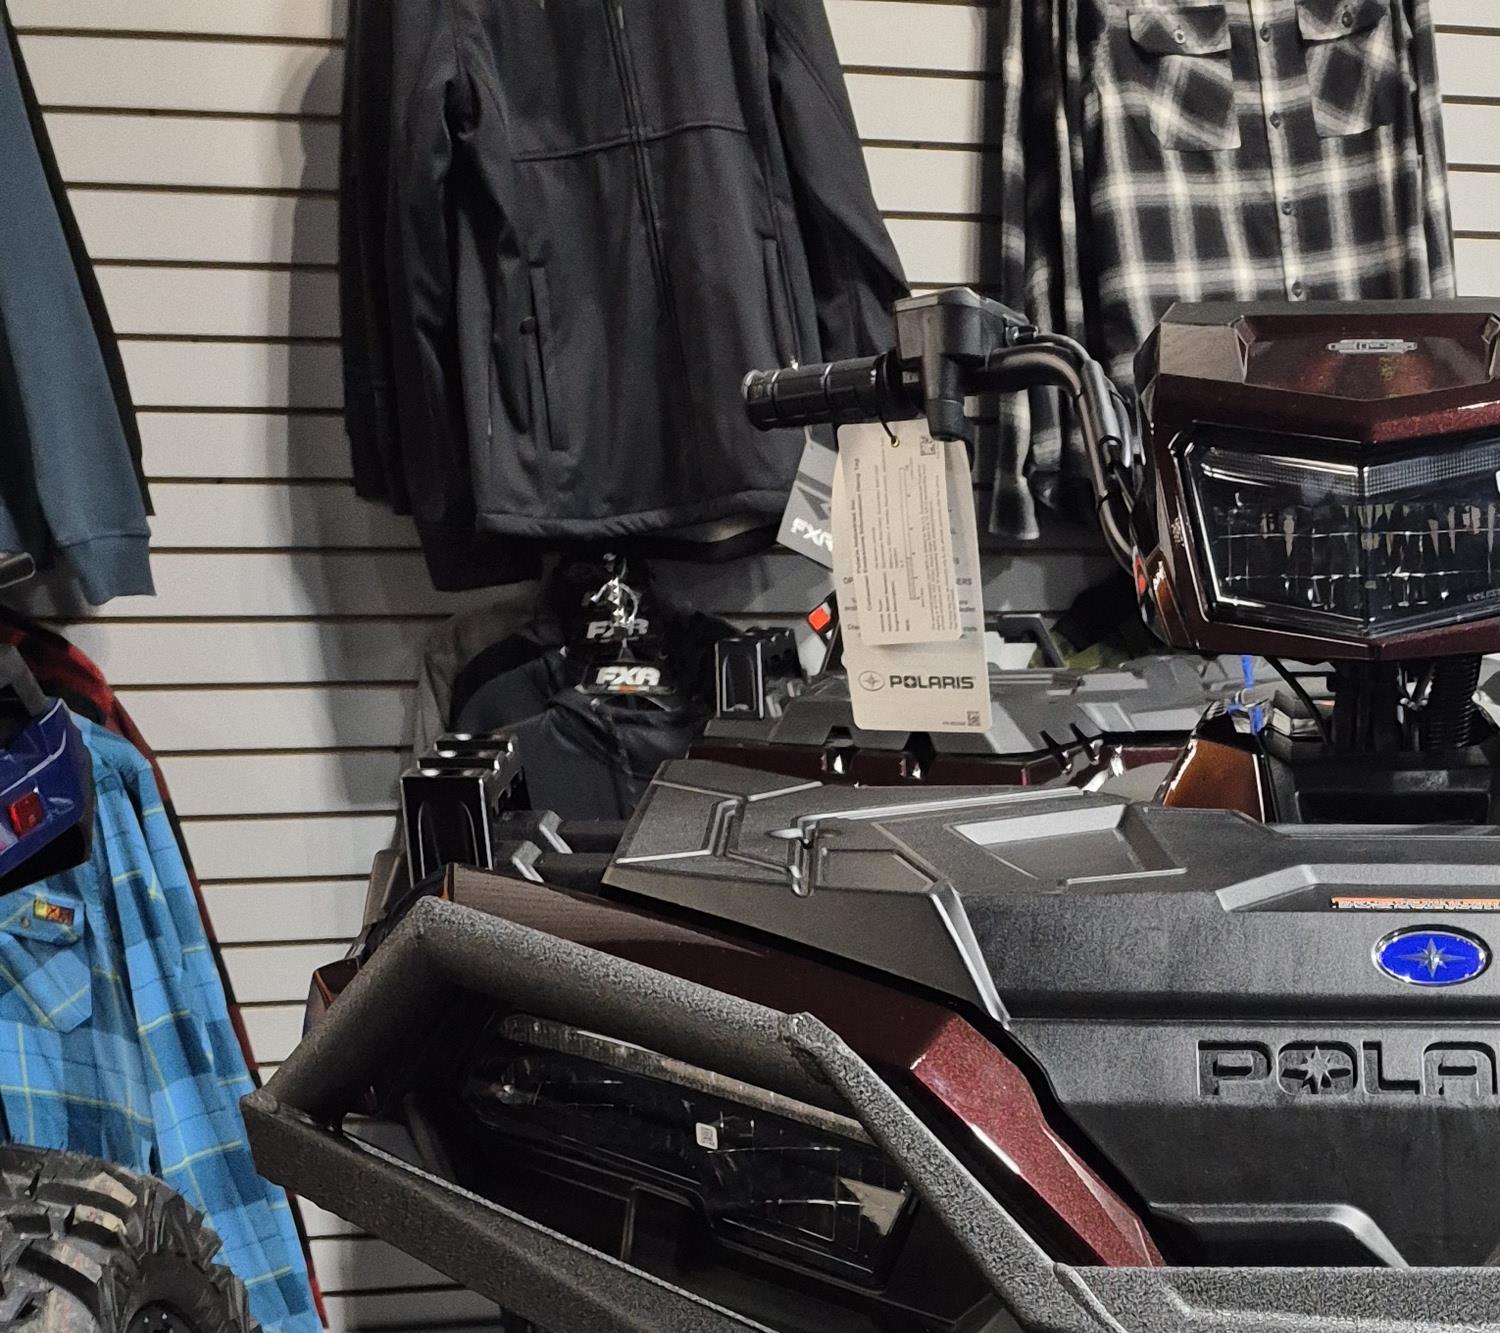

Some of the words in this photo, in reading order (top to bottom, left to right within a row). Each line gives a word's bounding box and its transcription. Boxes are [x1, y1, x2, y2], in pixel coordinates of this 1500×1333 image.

[790, 517, 833, 552] FXR
[595, 665, 661, 686] FXR
[889, 675, 975, 690] POLARIS
